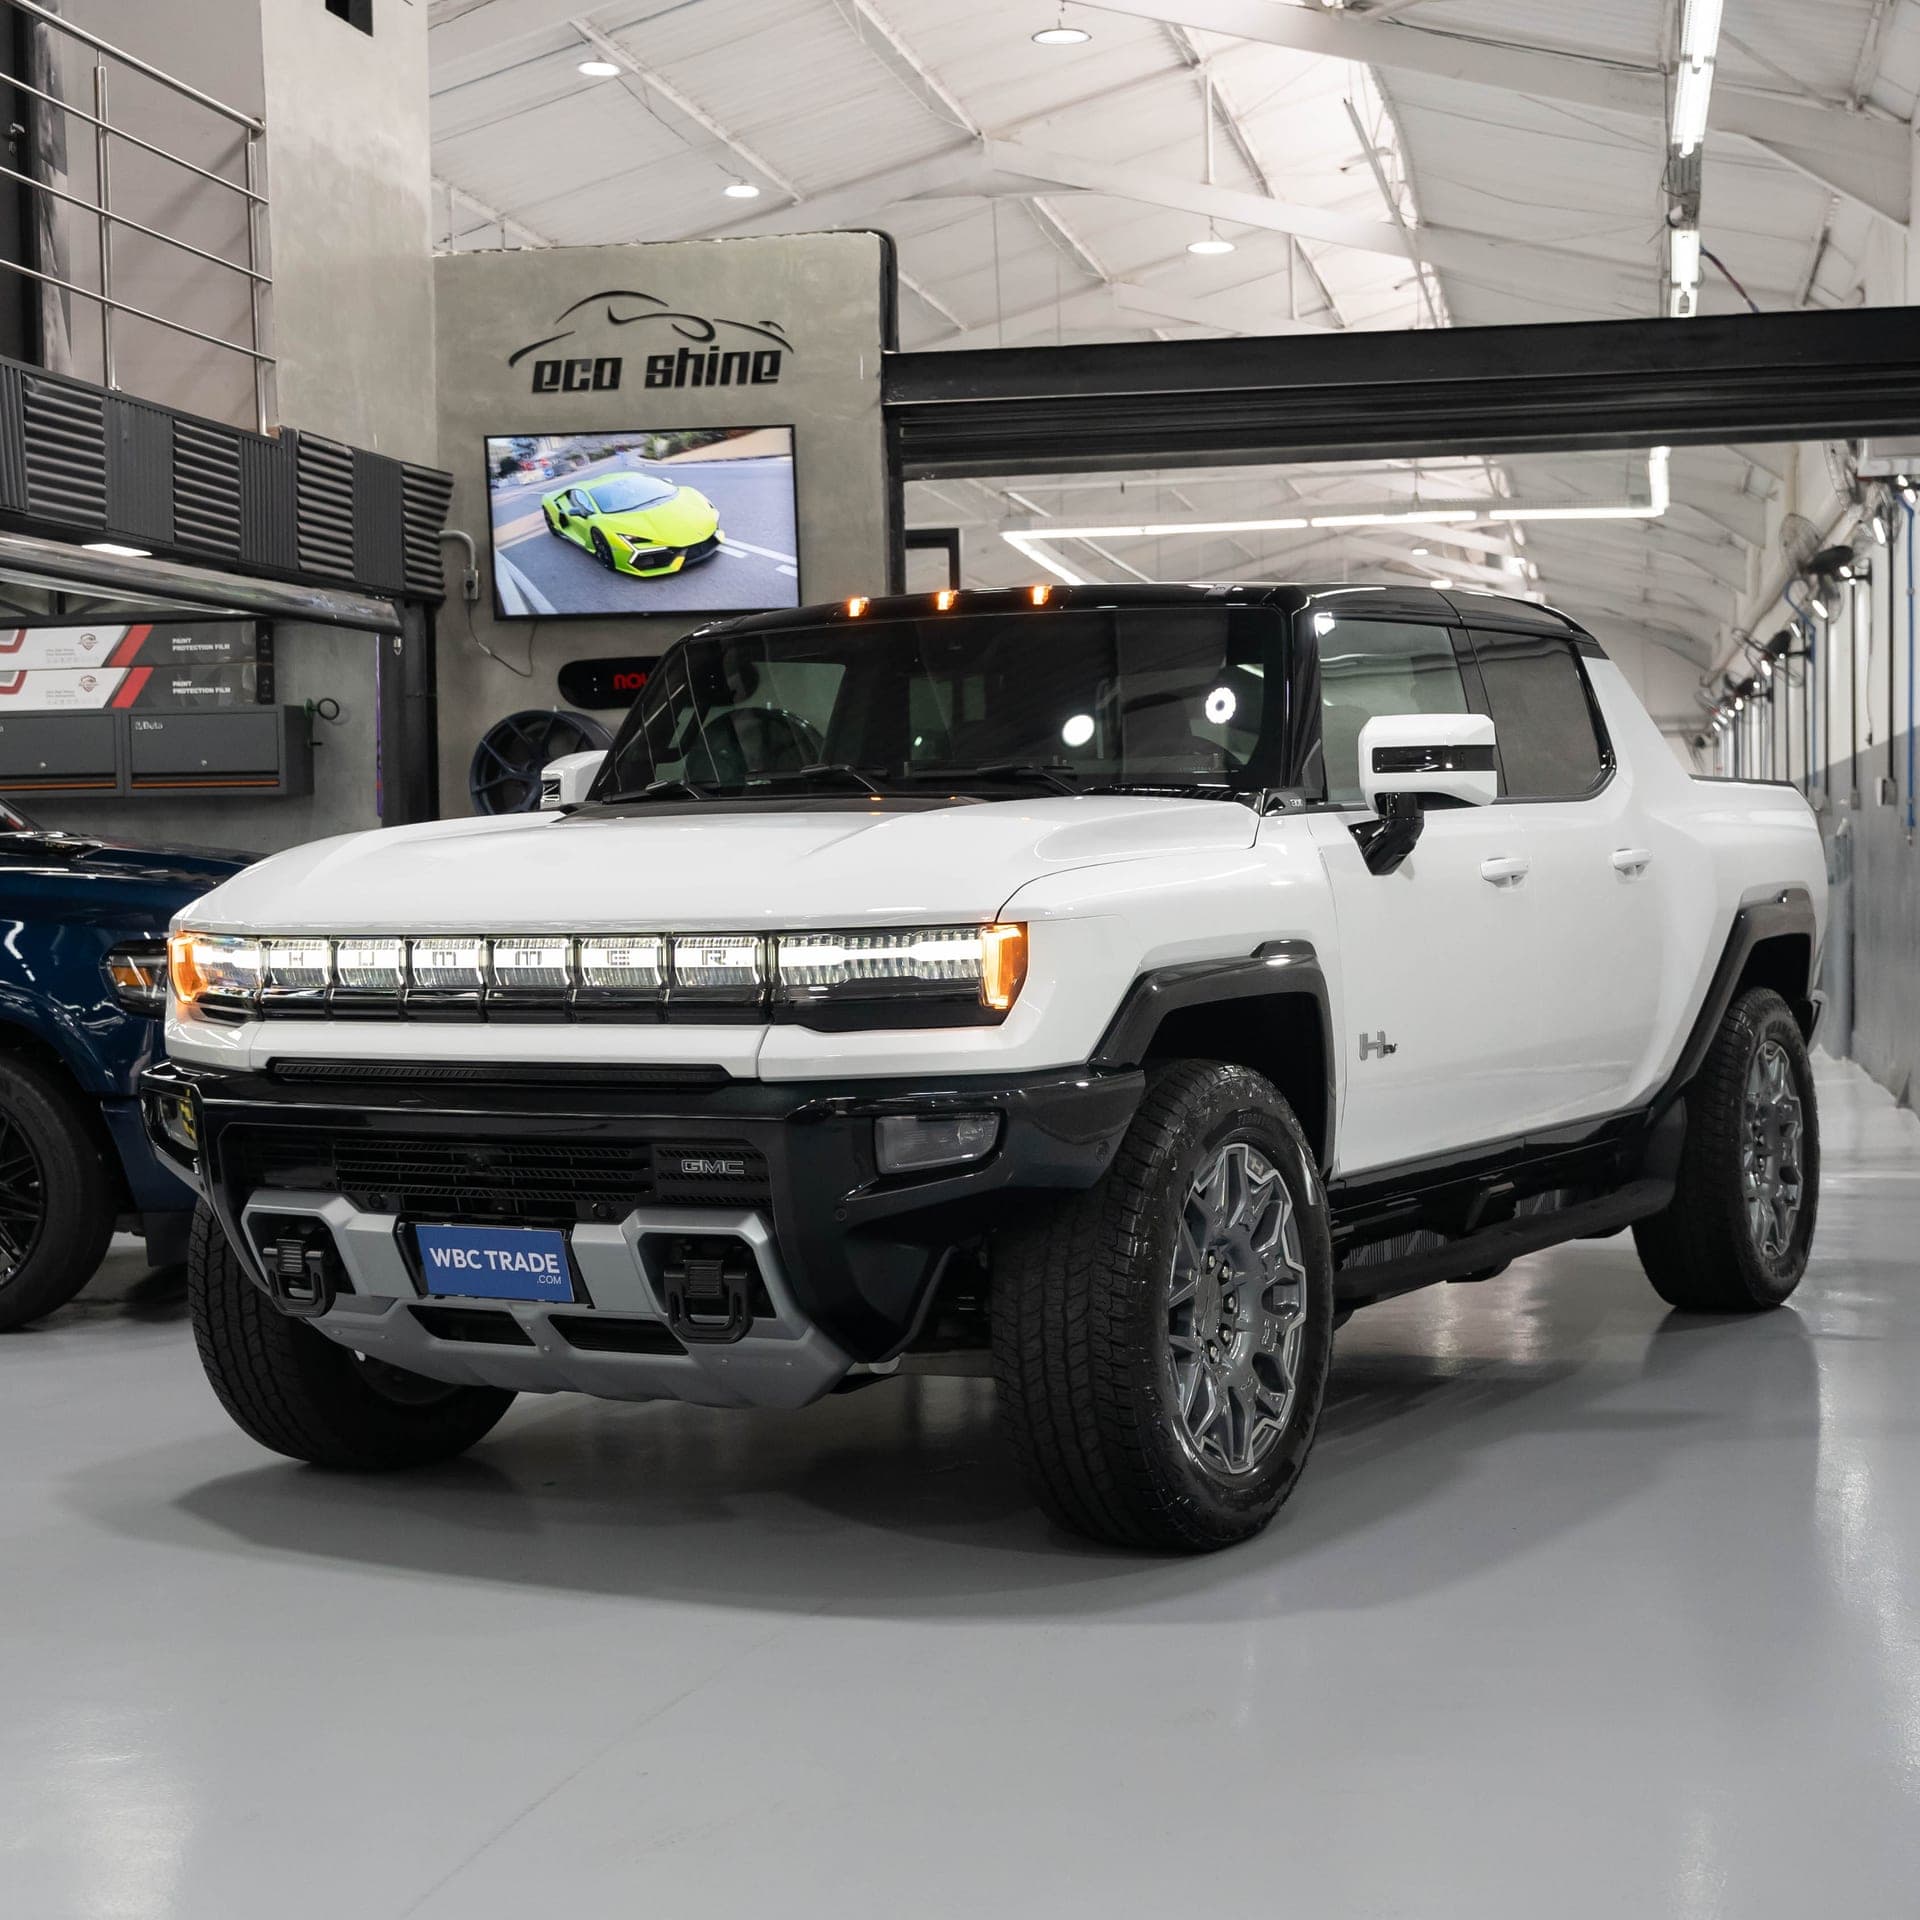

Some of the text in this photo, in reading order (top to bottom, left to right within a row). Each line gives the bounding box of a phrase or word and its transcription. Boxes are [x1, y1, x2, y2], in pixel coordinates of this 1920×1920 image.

[532, 346, 782, 393] eco shine
[172, 644, 214, 652] PROTECTION
[172, 686, 231, 695] PROTECTION FILM
[681, 1159, 744, 1174] GMC
[429, 1247, 560, 1274] WBC TRADE
[536, 1274, 562, 1285] .COM
